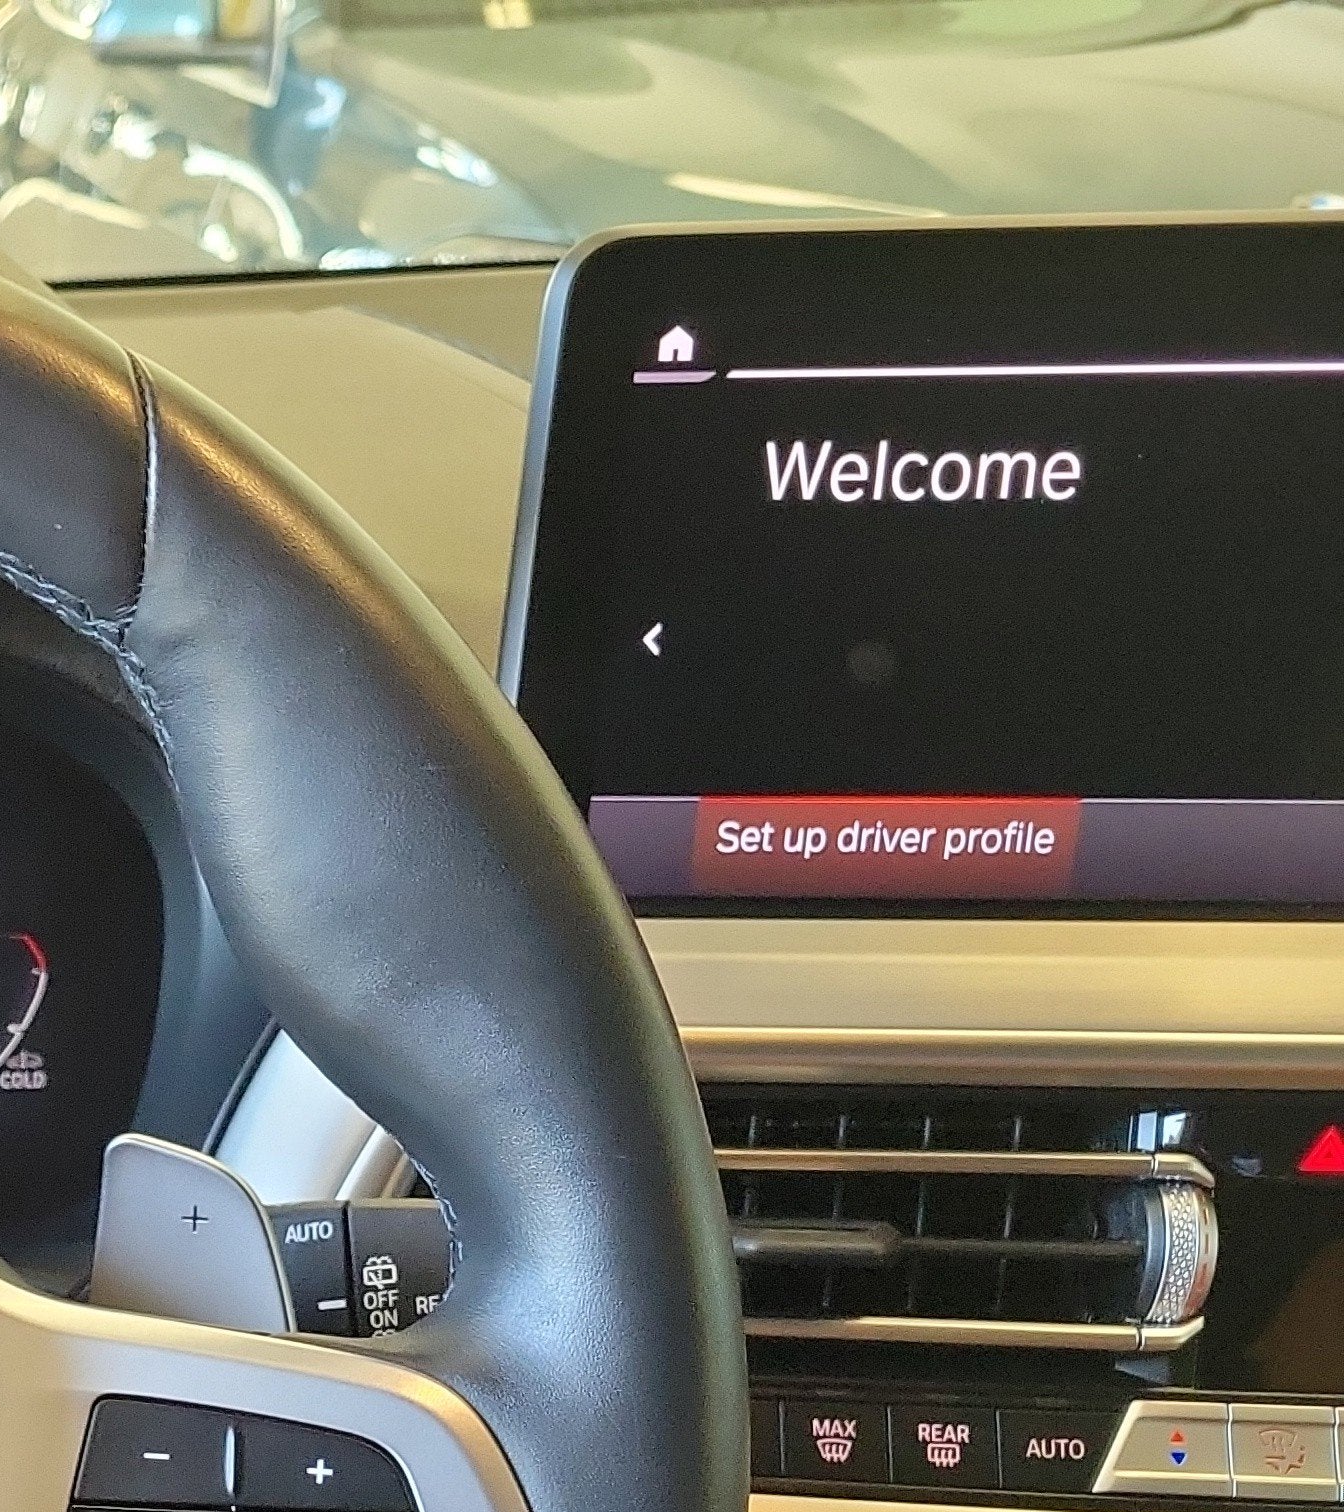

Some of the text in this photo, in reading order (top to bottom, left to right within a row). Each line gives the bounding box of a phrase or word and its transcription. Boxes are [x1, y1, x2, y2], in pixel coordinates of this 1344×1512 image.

[764, 440, 1082, 502] Welcome
[716, 819, 1055, 860] Set up driver profile
[0, 1070, 48, 1090] COLD
[285, 1220, 333, 1244] AUTO
[363, 1289, 399, 1310] OFF
[370, 1308, 398, 1328] ON
[812, 1418, 857, 1439] MAX
[917, 1422, 970, 1445] REAR
[1025, 1437, 1086, 1461] AUTO
